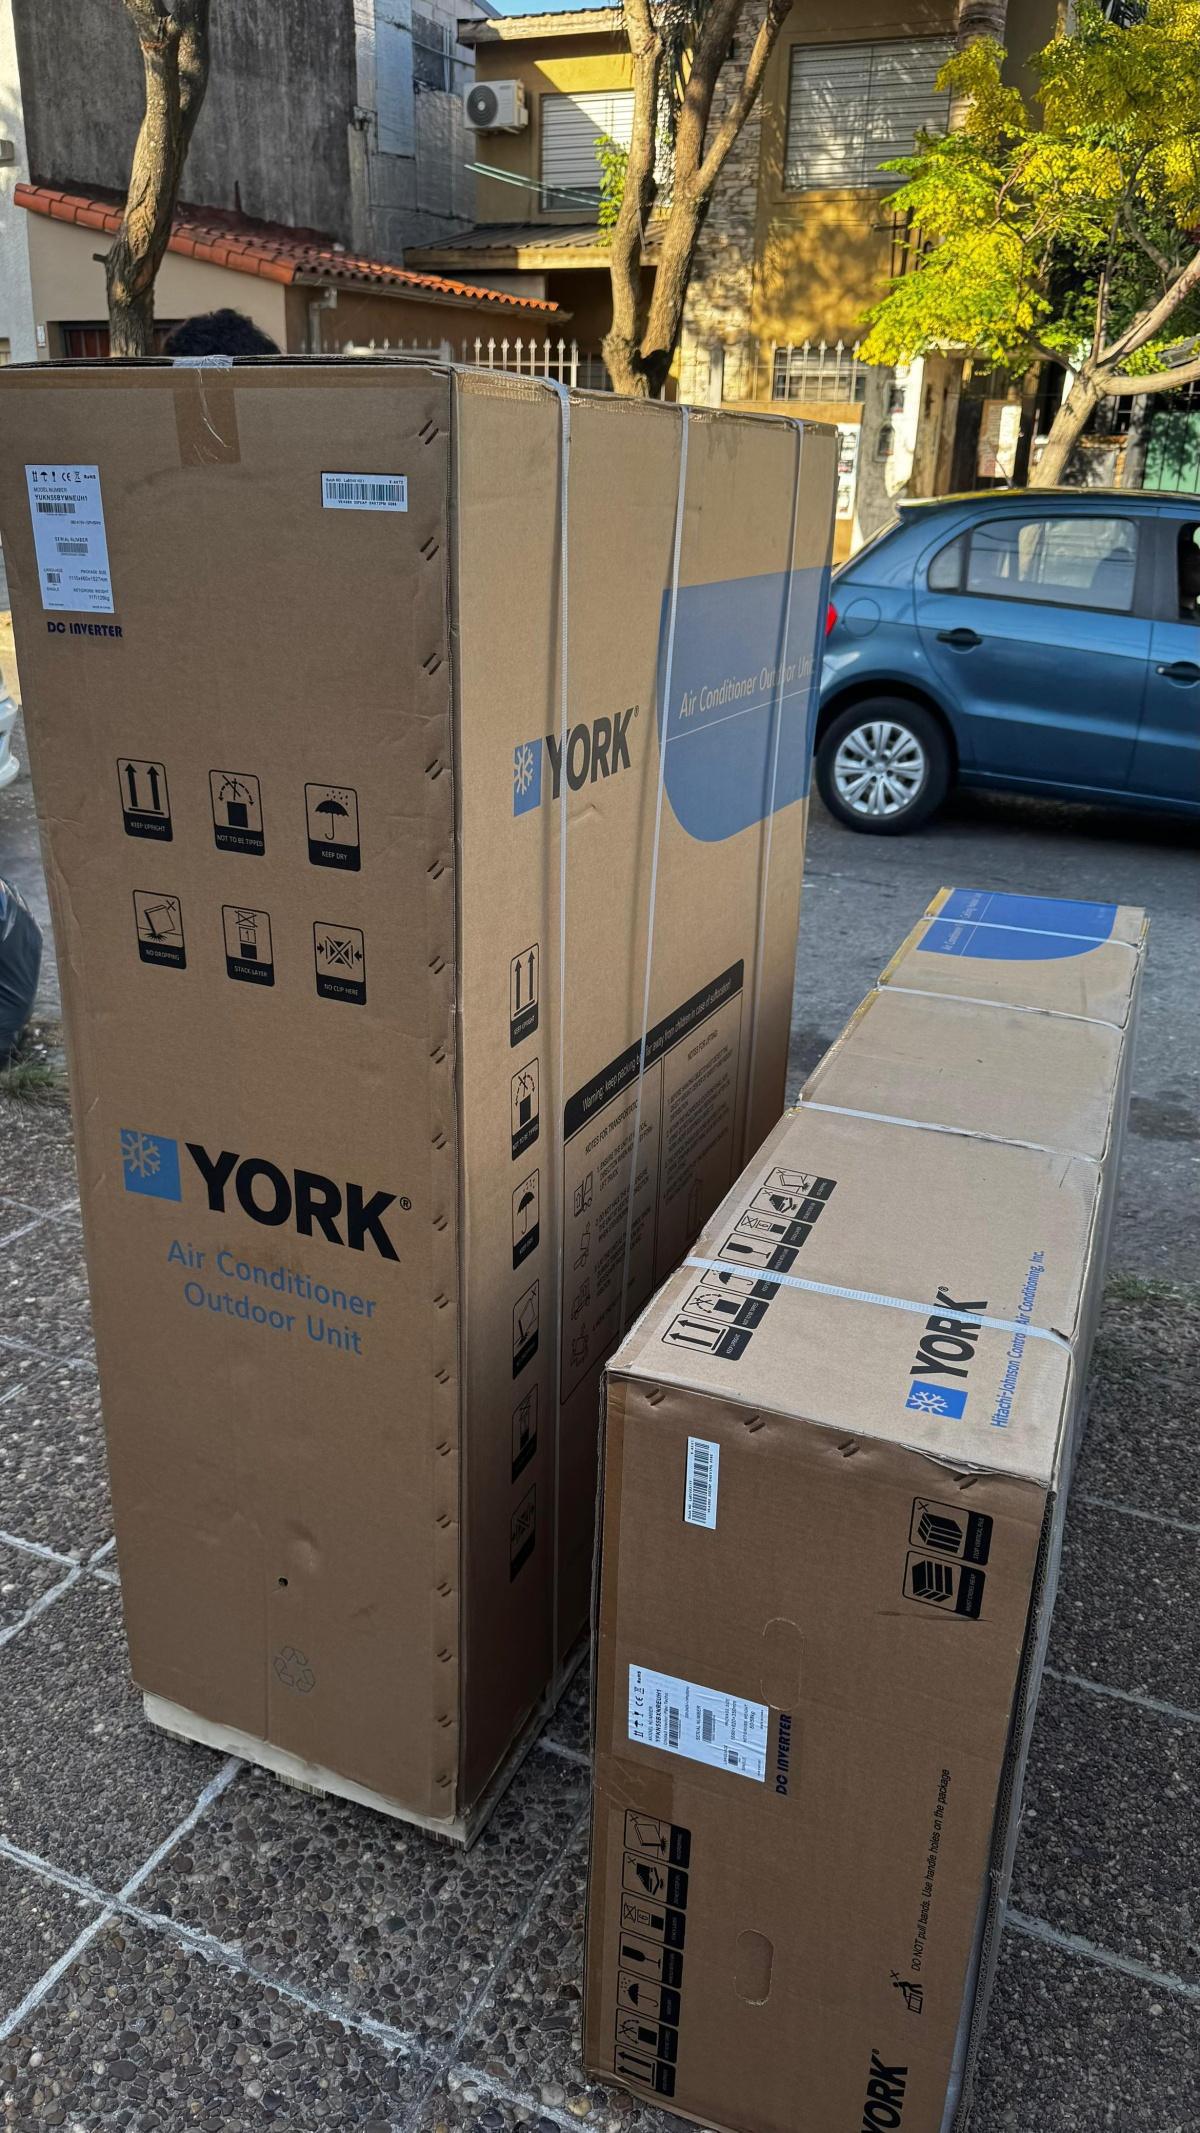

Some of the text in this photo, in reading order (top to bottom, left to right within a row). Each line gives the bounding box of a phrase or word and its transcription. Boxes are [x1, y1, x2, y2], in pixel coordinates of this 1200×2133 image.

[47, 621, 123, 638] DC INVERTER
[679, 692, 697, 720] Air
[699, 674, 758, 713] Conditioner
[130, 821, 144, 829] KEEP
[217, 834, 228, 842] NOT
[321, 850, 348, 861] KEEP DRY
[146, 949, 154, 957] NO
[234, 965, 251, 975] STACK
[324, 983, 332, 991] NO
[583, 1084, 605, 1111] Warning:
[605, 1075, 618, 1090] keep
[617, 1060, 636, 1080] packing
[600, 1128, 609, 1141] FOR
[167, 1240, 377, 1319] Air Conditioner
[183, 1281, 363, 1355] Outdoor Unit
[989, 1360, 1020, 1427] Hitachi-Johnson
[1027, 1250, 1044, 1262] Inc.
[775, 1714, 793, 1795] DC INVERTER
[910, 1769, 951, 1971] DO NOT pull bands. Use handle holes on the package
